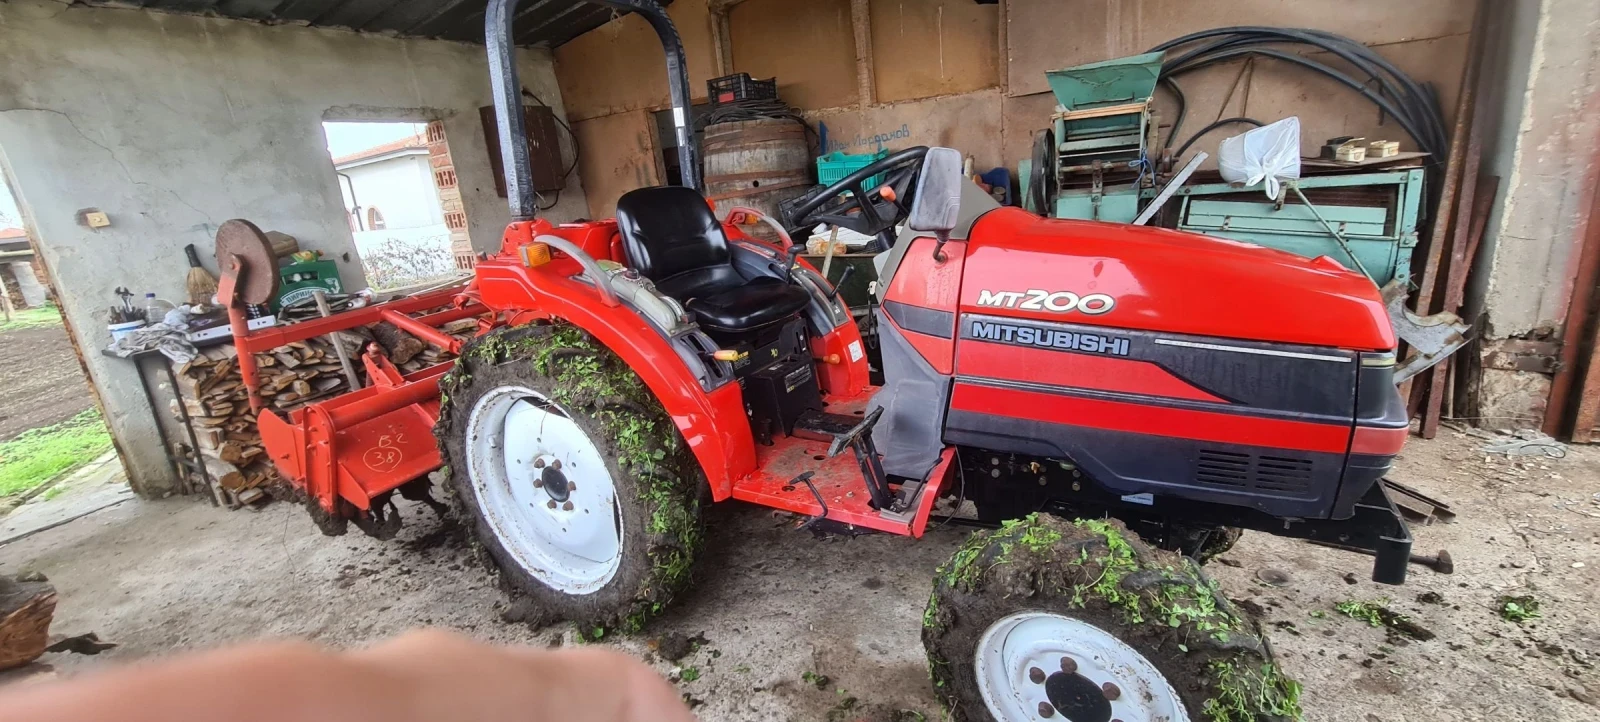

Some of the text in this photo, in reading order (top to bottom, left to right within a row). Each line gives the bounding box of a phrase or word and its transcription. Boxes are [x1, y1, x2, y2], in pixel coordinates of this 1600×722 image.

[977, 288, 1116, 316] MT200
[971, 321, 1131, 357] MITSUBISHI
[372, 451, 395, 467] 38
